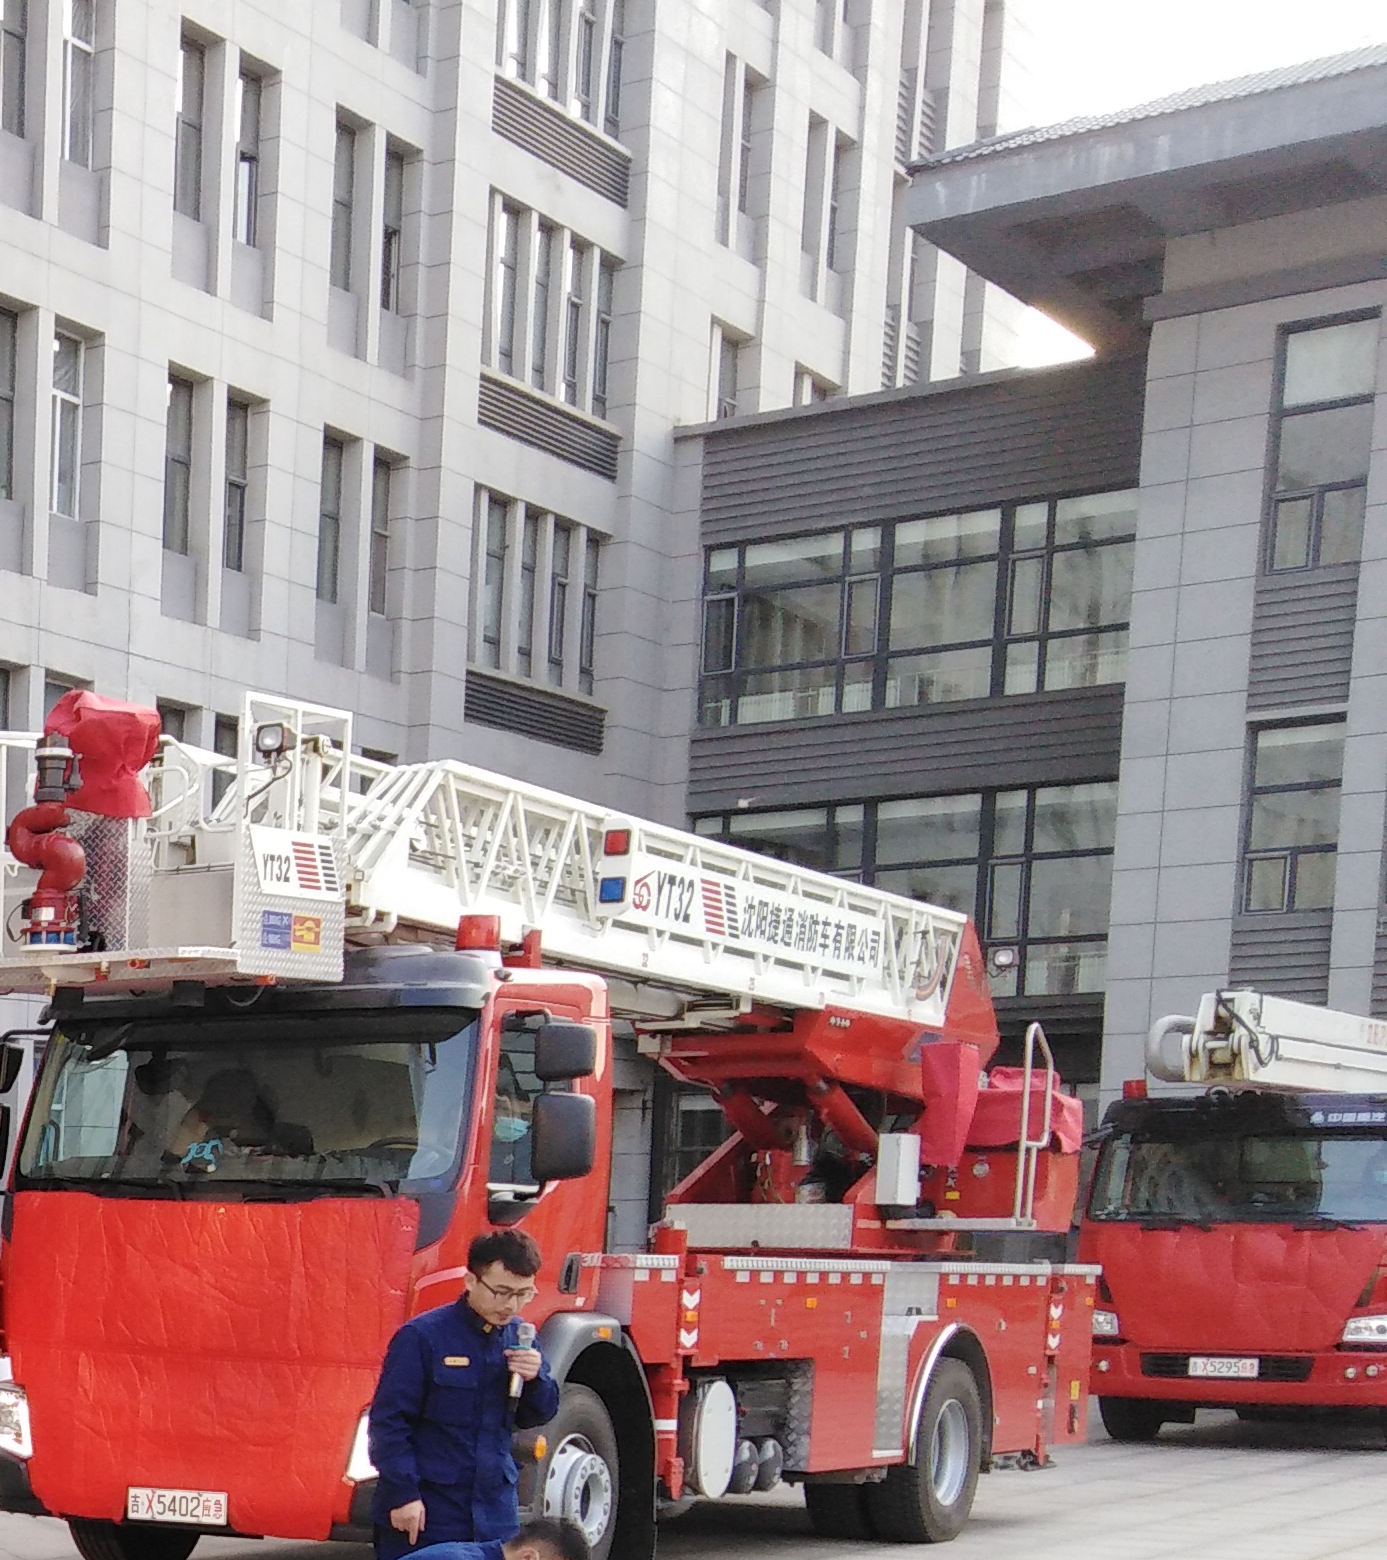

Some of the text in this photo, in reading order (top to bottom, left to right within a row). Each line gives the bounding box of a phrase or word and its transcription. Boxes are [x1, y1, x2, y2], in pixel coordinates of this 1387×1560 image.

[262, 853, 291, 883] YT32
[654, 870, 882, 968] YT32 沈阳捷通消防车有限公司
